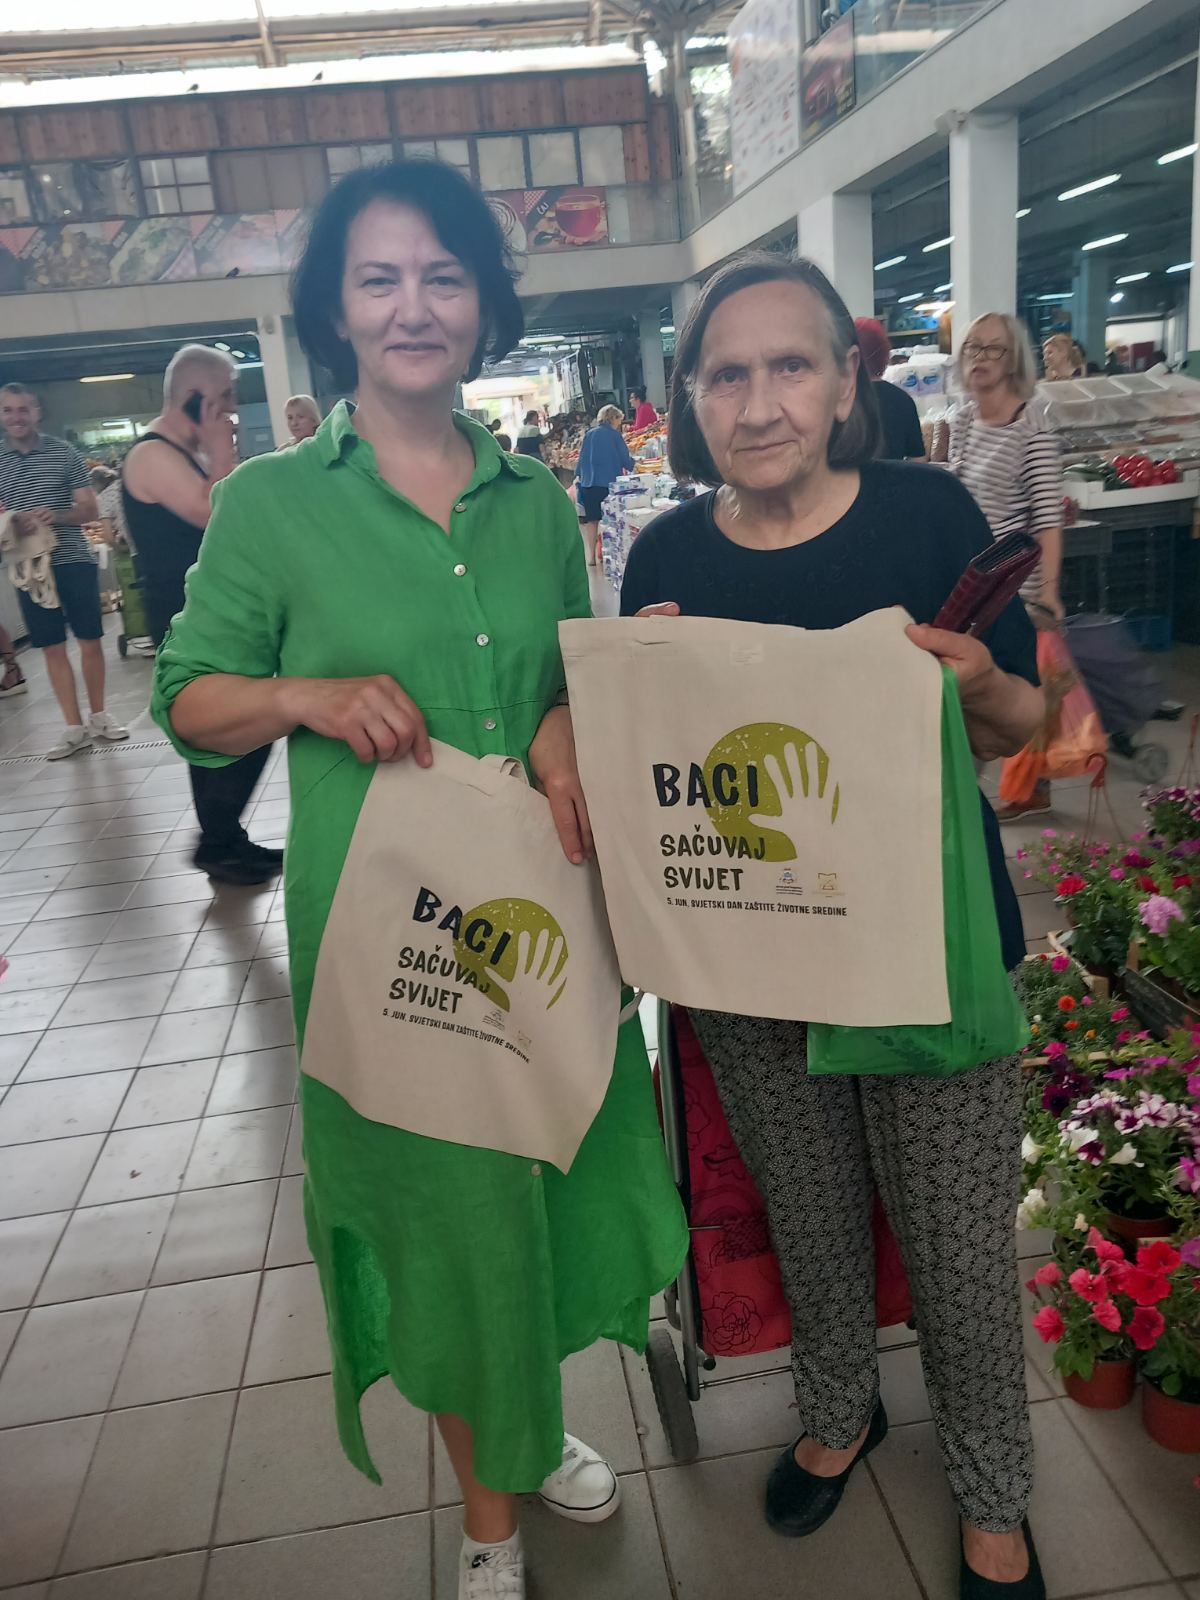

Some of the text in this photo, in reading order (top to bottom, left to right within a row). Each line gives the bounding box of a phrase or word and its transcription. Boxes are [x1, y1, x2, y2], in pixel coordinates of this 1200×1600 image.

[652, 762, 759, 808] BACI
[660, 824, 766, 860] SAČUVAJ
[663, 866, 744, 891] SVIJET
[667, 897, 847, 916] 5. JUN. SVJETSKI DAN ZAŠTITE ŽIVOTNE SREDINE
[412, 886, 511, 966] BACI
[398, 944, 491, 994] SAČUVAJ
[389, 978, 463, 1014] SVIJET
[382, 1008, 389, 1016] 5.
[391, 1011, 407, 1022] JUN.
[409, 1014, 441, 1029] SVJETSKI
[442, 1021, 456, 1032] DAN
[456, 1025, 479, 1038] ZAŠTITE
[479, 1029, 505, 1046] ŽIVOTNE
